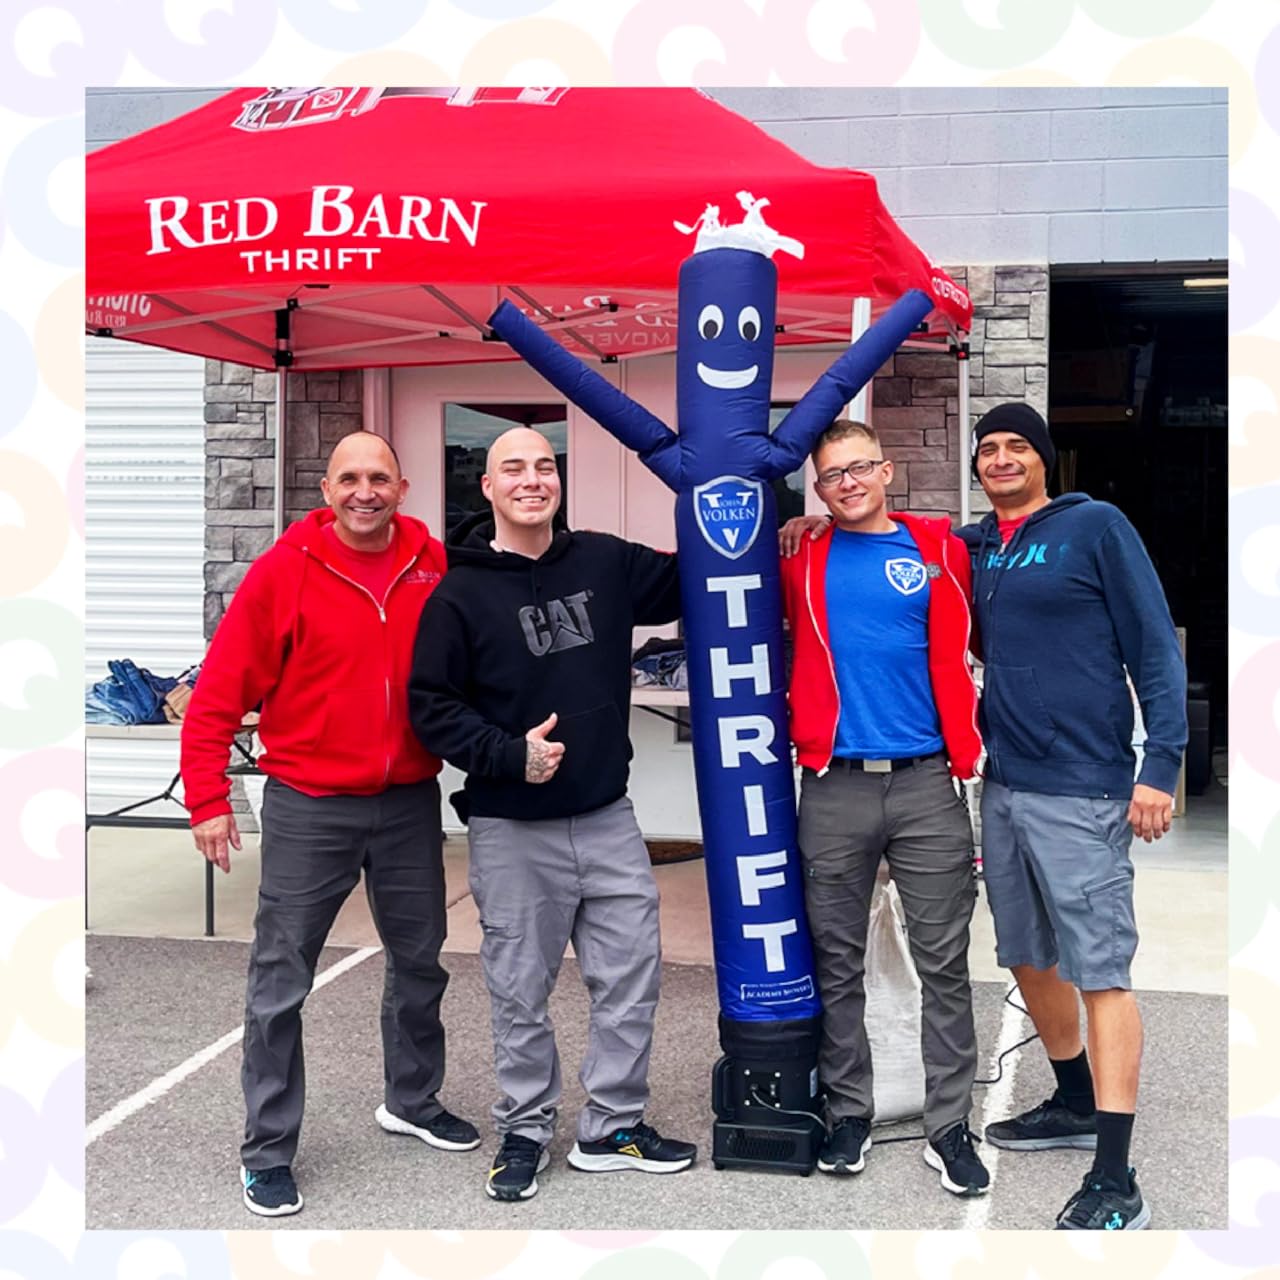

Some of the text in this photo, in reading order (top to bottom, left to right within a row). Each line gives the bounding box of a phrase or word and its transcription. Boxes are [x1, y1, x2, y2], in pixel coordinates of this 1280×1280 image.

[145, 185, 487, 255] RED BARN
[240, 248, 381, 272] THRIFT
[702, 508, 755, 522] VOLKEN
[518, 590, 594, 656] CAT
